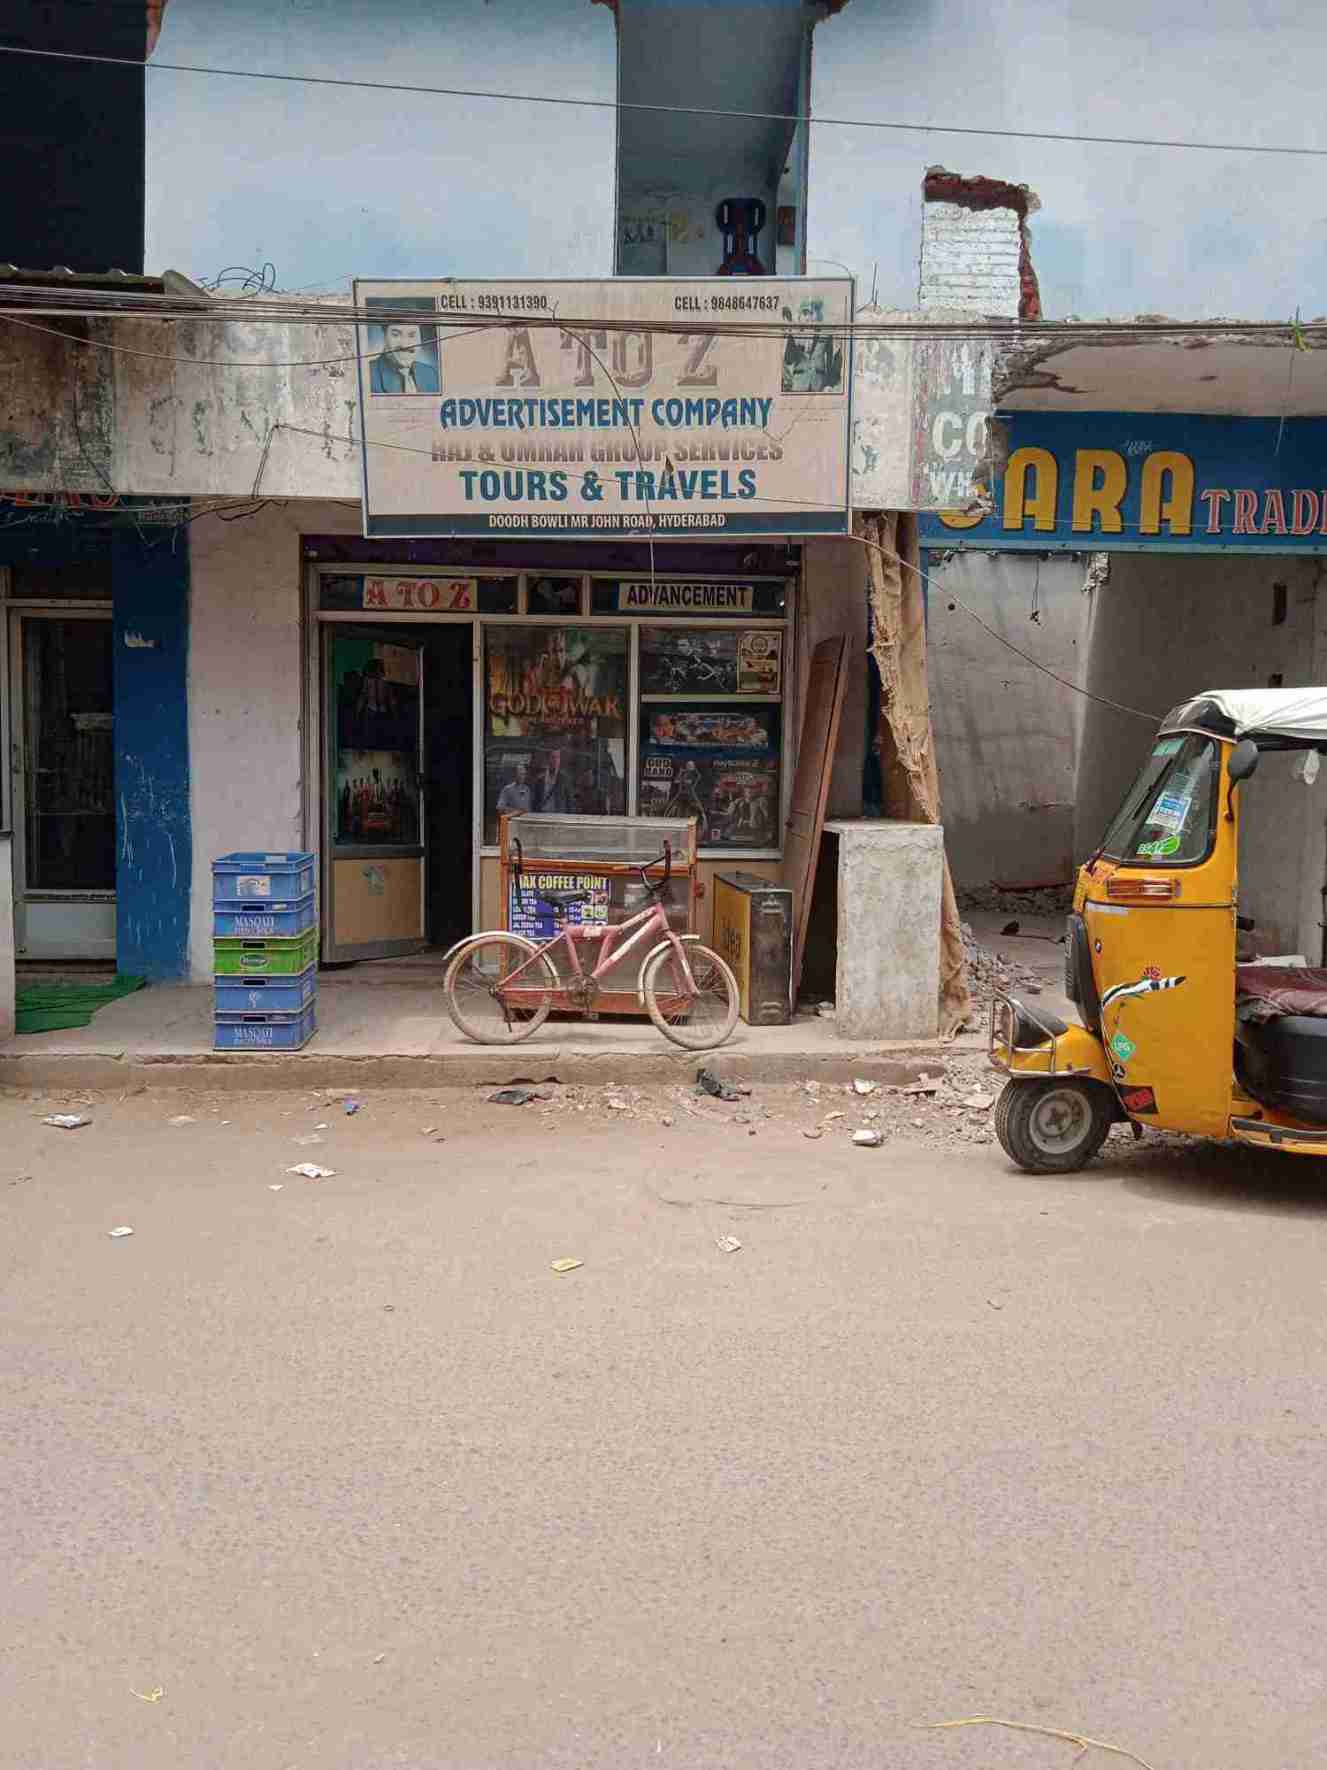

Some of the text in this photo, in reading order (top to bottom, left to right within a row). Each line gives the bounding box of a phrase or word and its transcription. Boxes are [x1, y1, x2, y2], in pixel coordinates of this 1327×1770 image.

[440, 295, 467, 309] CELL
[674, 296, 700, 310] CELL
[496, 325, 540, 386] A
[677, 330, 717, 386] Z
[440, 397, 773, 429] ADVERTISEMENT COMPANY
[674, 440, 783, 461] SERVICES
[459, 469, 757, 501] TOURS & TRAVELS
[938, 446, 1196, 534] ARA
[489, 514, 529, 528] DOODH
[531, 515, 568, 528] BOWLI
[570, 515, 589, 528] MR
[591, 514, 620, 528] JOHN
[658, 514, 726, 528] HYDERABAD
[367, 581, 388, 607] A
[450, 582, 471, 609] Z
[627, 584, 747, 607] ADVANCEMENT
[538, 875, 575, 889] COFFEE
[576, 876, 609, 890] POINT
